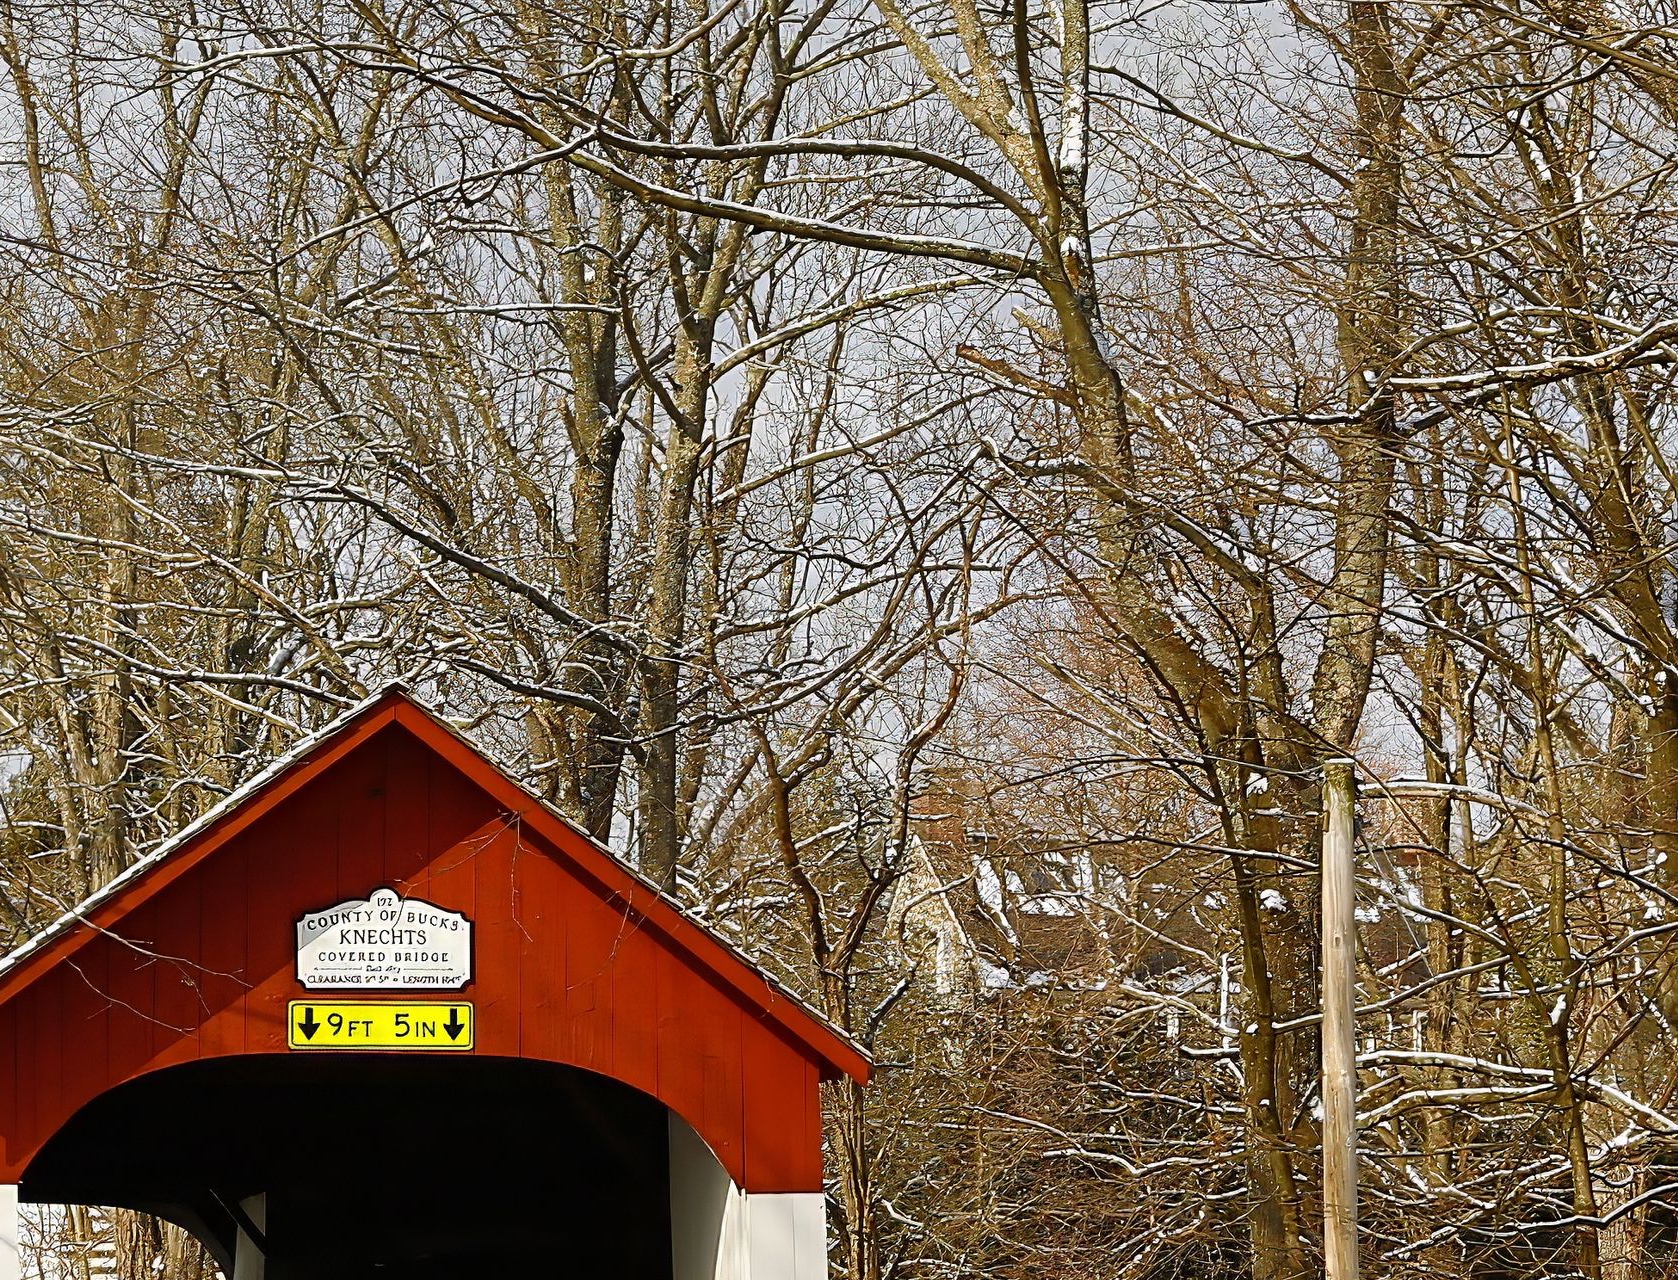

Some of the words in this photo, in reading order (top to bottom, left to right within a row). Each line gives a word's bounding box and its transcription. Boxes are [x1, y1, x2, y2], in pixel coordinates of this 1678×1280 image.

[307, 910, 373, 930] COUNTY
[380, 910, 397, 921] OF
[407, 912, 458, 931] BUCKS
[339, 929, 427, 945] KNECHTS
[318, 952, 385, 962] COVERED
[394, 952, 450, 962] BRIDGE
